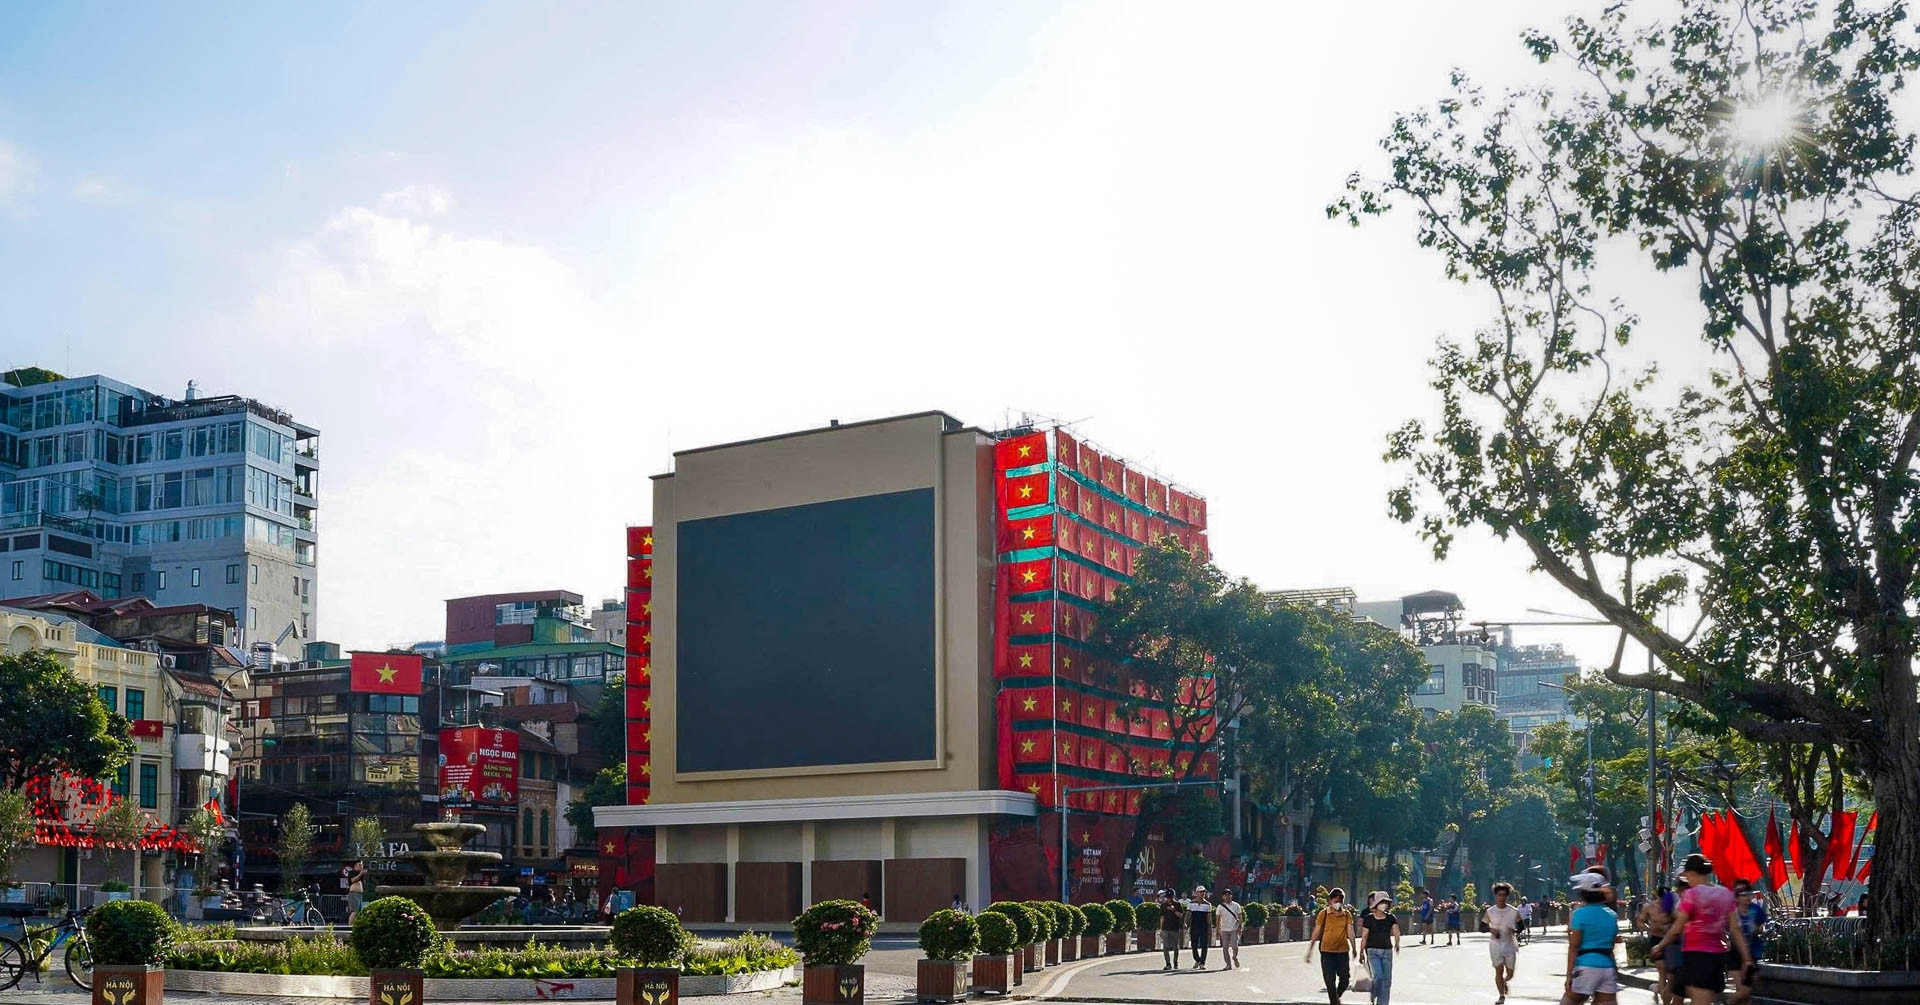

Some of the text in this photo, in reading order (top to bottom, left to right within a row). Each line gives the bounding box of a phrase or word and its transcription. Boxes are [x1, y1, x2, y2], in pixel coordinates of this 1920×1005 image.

[479, 748, 517, 760] NGỌC HOA
[368, 860, 397, 871] Café
[105, 980, 133, 990] HÀ NỘI
[383, 982, 411, 992] HÀ NỘI
[644, 981, 668, 991] HÀ NỘI
